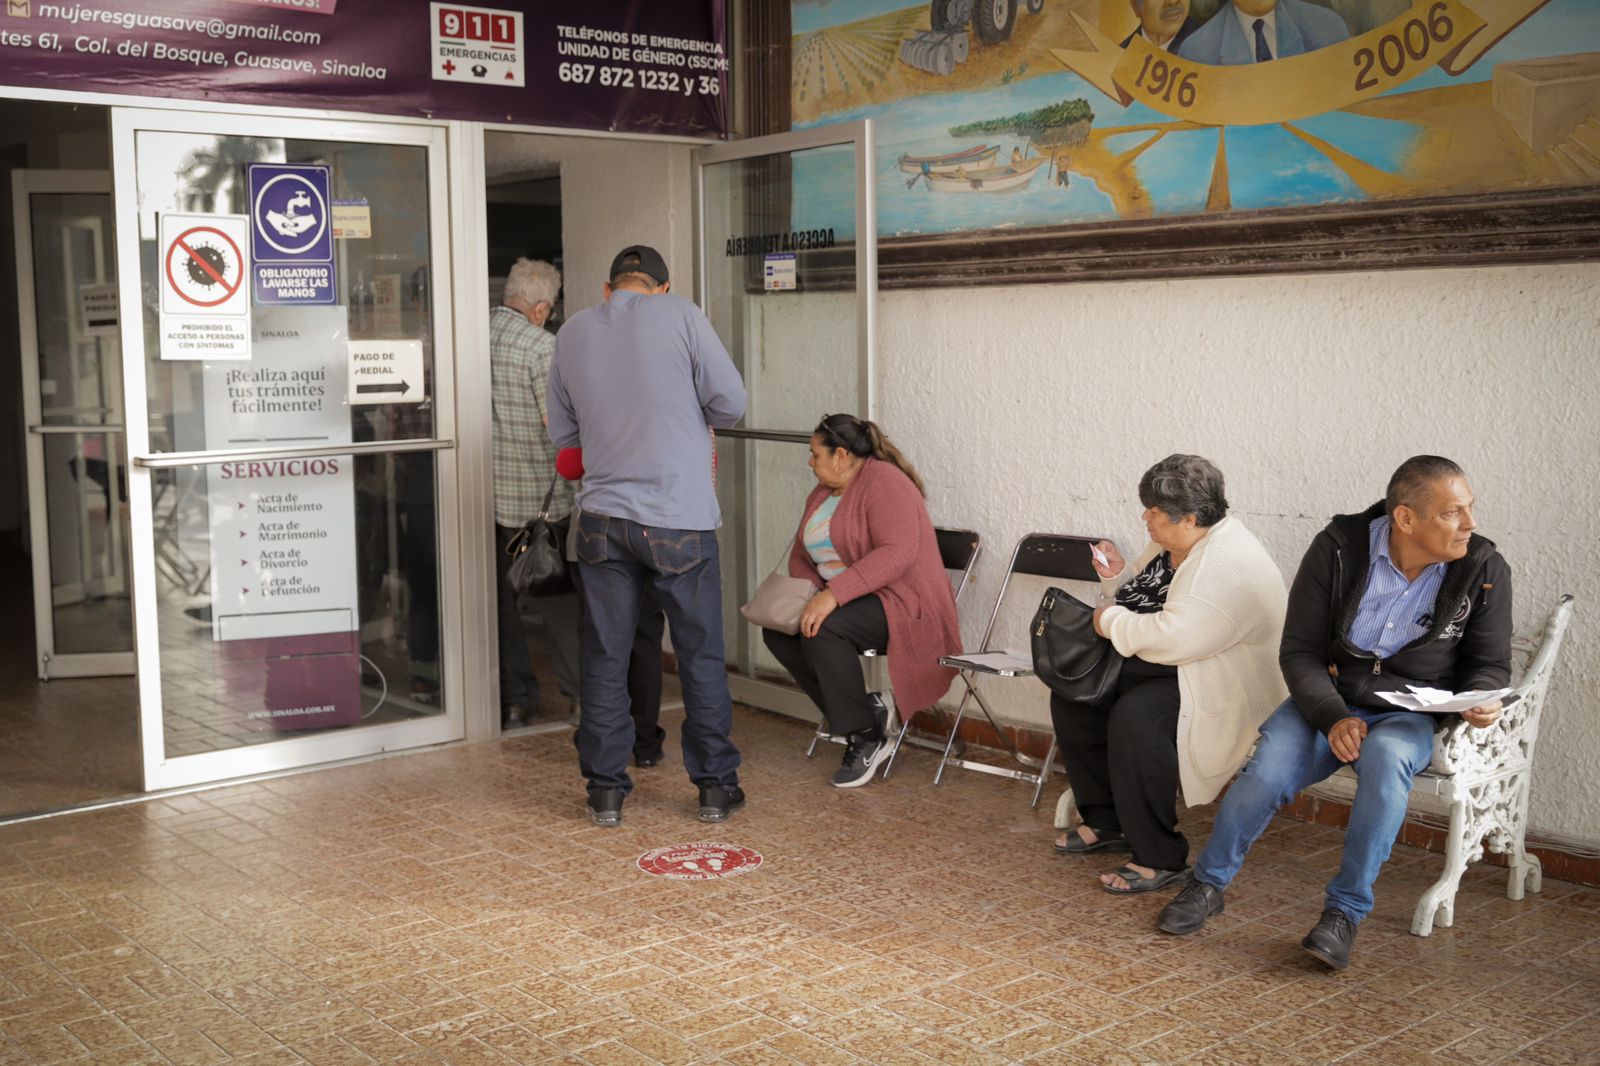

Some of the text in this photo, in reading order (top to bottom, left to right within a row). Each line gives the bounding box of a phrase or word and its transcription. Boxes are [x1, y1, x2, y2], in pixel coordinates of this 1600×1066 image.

[38, 3, 322, 45] mujeresguasave@gmail.com
[444, 13, 508, 40] 911
[557, 24, 724, 55] TELÉFONOS DE EMERGENCIA
[557, 40, 609, 59] UNIDAD
[612, 46, 630, 60] DE
[632, 47, 685, 67] GÉNERO
[1353, 2, 1454, 92] 2006
[38, 32, 63, 53] 61,
[74, 35, 111, 54] Col.
[116, 40, 149, 57] del
[153, 42, 229, 68] Bosque,
[233, 51, 317, 76] Guasave,
[321, 59, 387, 80] Sinaloa
[439, 46, 517, 63] EMERGENCIAS
[558, 61, 720, 96] 687 872 1232 y 36
[1134, 53, 1199, 108] 1916
[259, 268, 329, 279] OBLIGATORIO
[262, 278, 329, 289] LAVARSE LAS
[277, 287, 316, 299] MANOS
[181, 324, 234, 332] PROHIBIDO EL
[260, 330, 300, 338] SINALOA
[167, 332, 198, 340] ACCESO
[206, 333, 246, 341] PERSONAS
[353, 353, 395, 361] PAGO DE
[226, 366, 326, 385] ¡Realiza aquí
[228, 383, 325, 399] tus trámites
[232, 398, 322, 414] fácilmente!
[220, 459, 339, 480] SERVICIOS
[257, 492, 299, 504] Acta de
[257, 502, 323, 514] Nacimiento
[258, 520, 300, 532] Acta de
[258, 529, 328, 542] Matrimonio
[259, 548, 301, 560] Acta de
[260, 557, 309, 570] Divorcio
[288, 576, 303, 586] de
